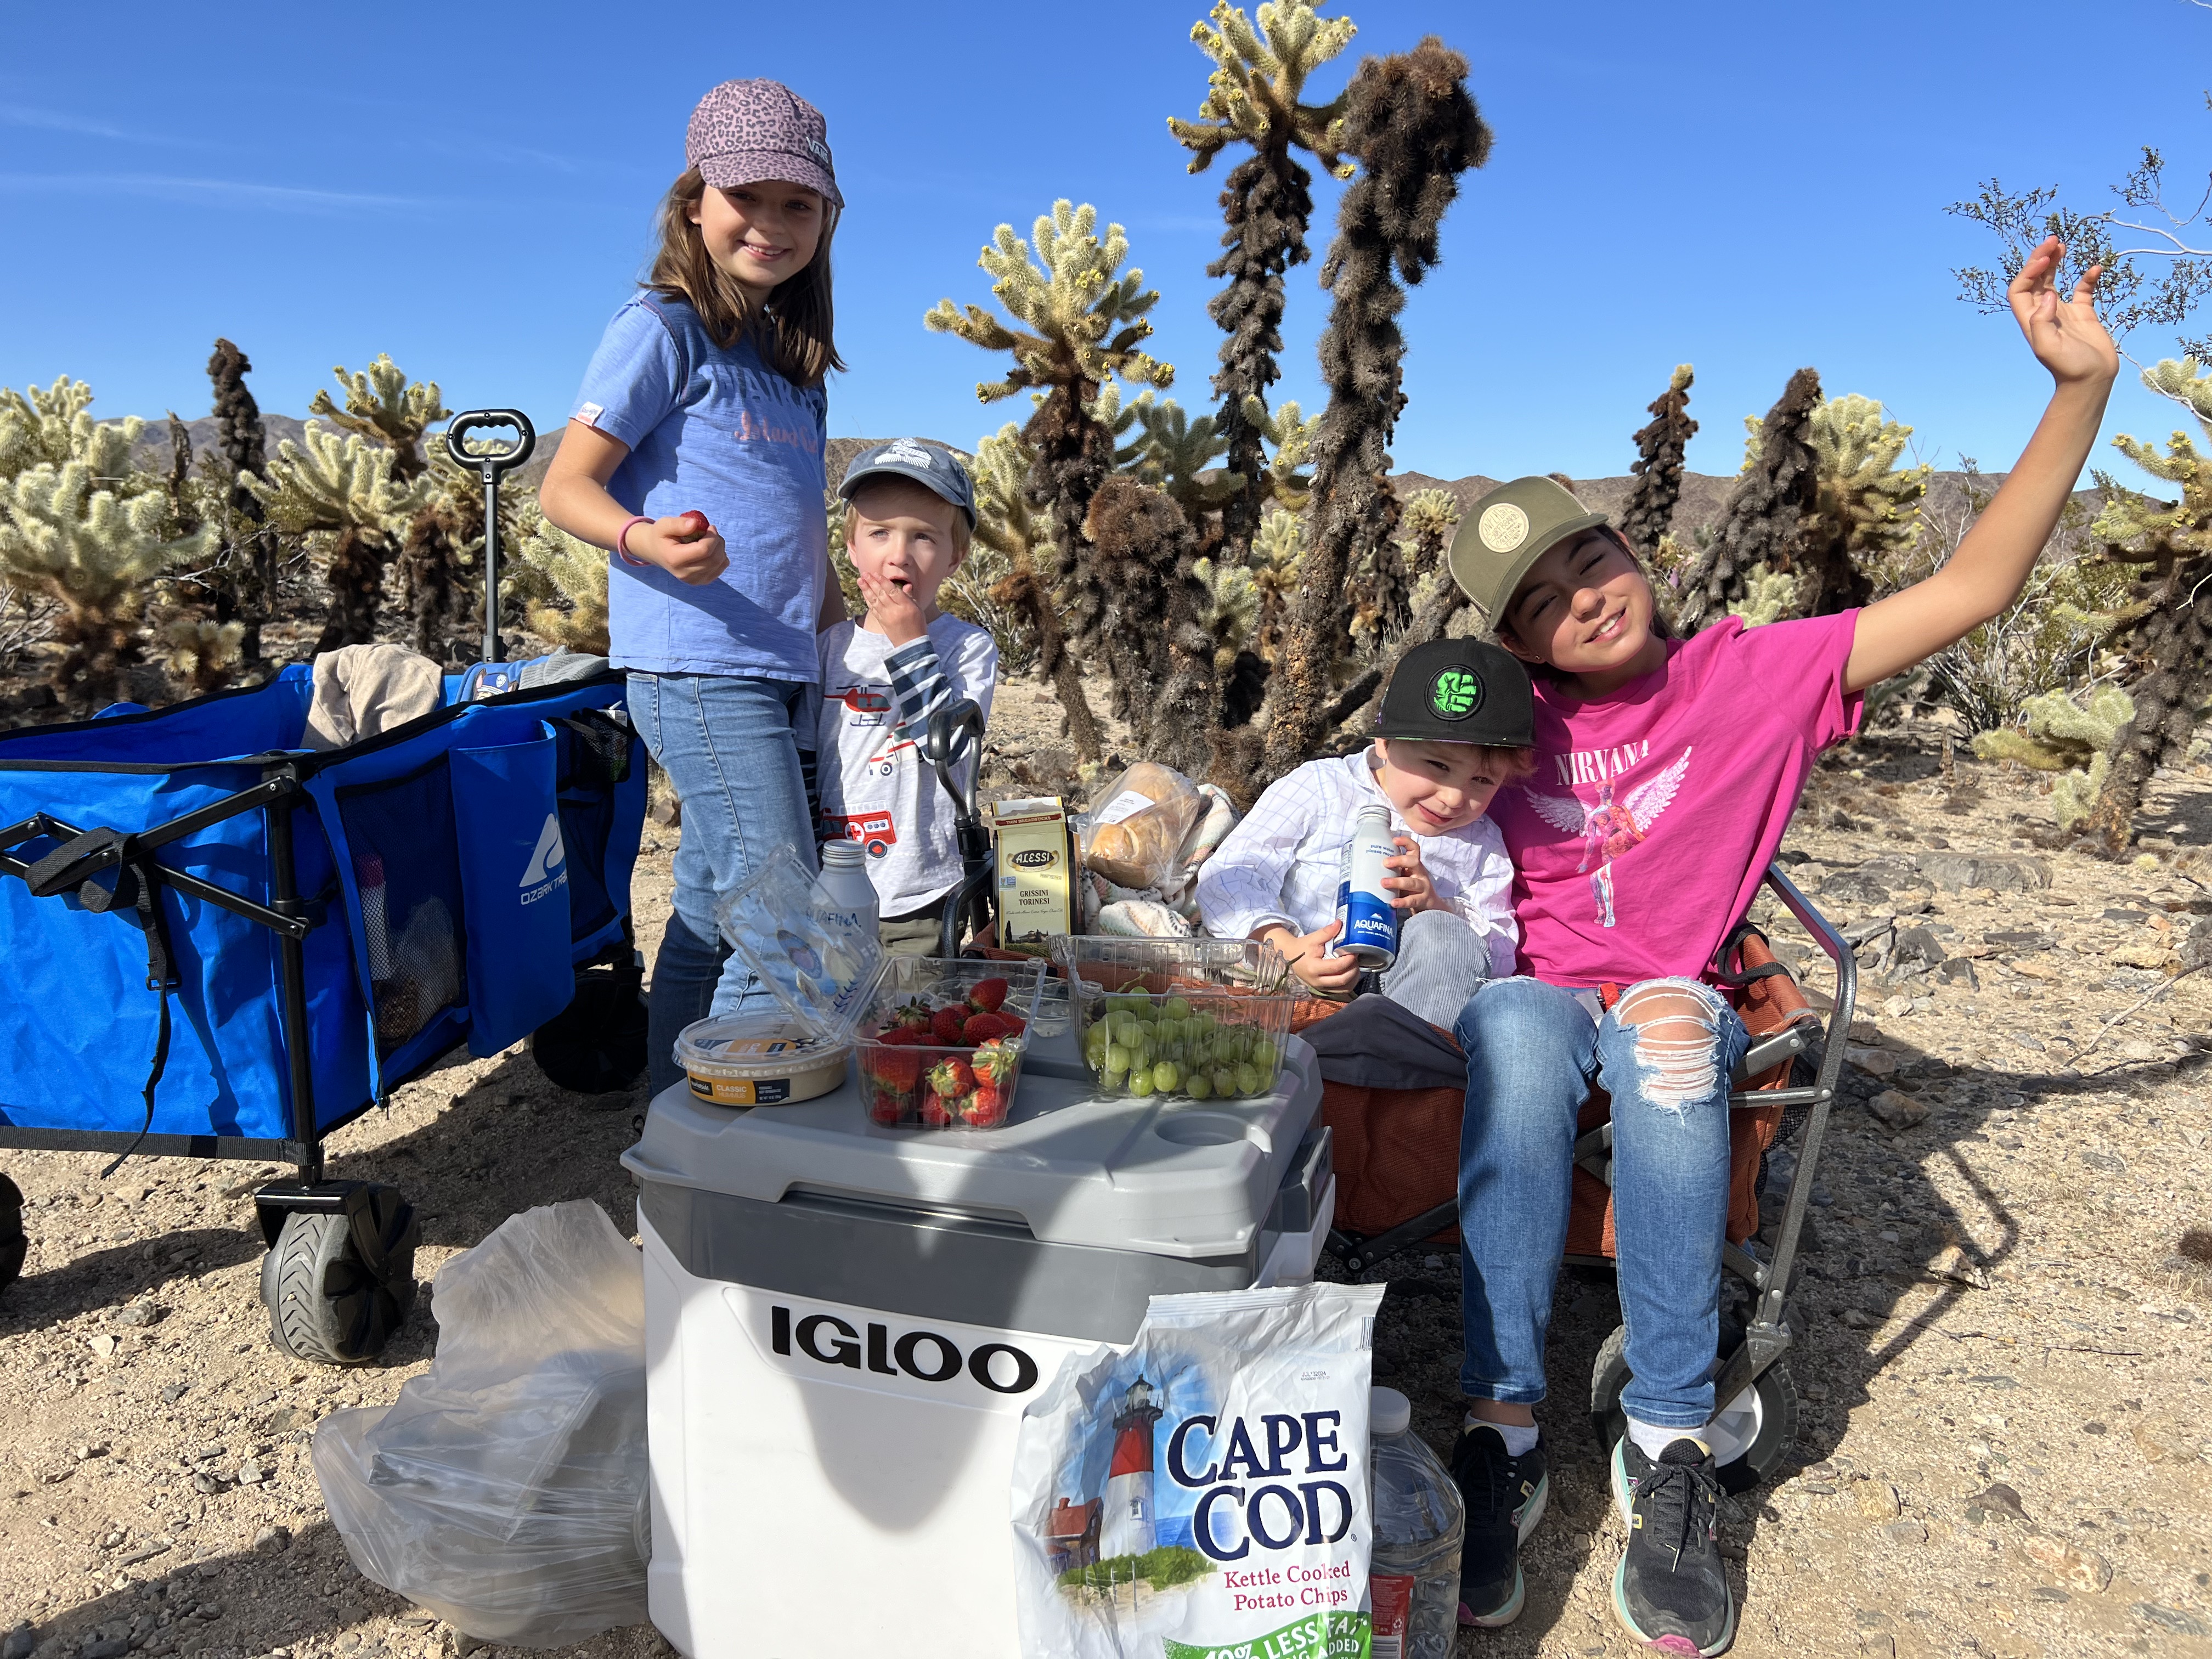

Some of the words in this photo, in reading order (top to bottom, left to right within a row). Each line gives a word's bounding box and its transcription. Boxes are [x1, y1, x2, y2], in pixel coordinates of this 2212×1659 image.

[806, 136, 829, 164] VANS
[1554, 739, 1649, 786] NIRVANA
[1015, 852, 1050, 864] ALESSI
[554, 868, 567, 889] TRA
[1019, 898, 1050, 906] TORINESI
[1020, 889, 1048, 898] GRISSINI
[1354, 919, 1394, 938] AQUAFINA
[716, 1084, 747, 1093] CLASSIC
[771, 1305, 1039, 1393] IGLOO
[1167, 1410, 1347, 1487] CAPE
[1194, 1480, 1352, 1561] COD
[1224, 1567, 1281, 1589] Kettle
[1286, 1560, 1351, 1583] Cooked
[1234, 1592, 1295, 1611] Potato
[1300, 1586, 1348, 1606] Chips
[1263, 1621, 1320, 1659] LESS
